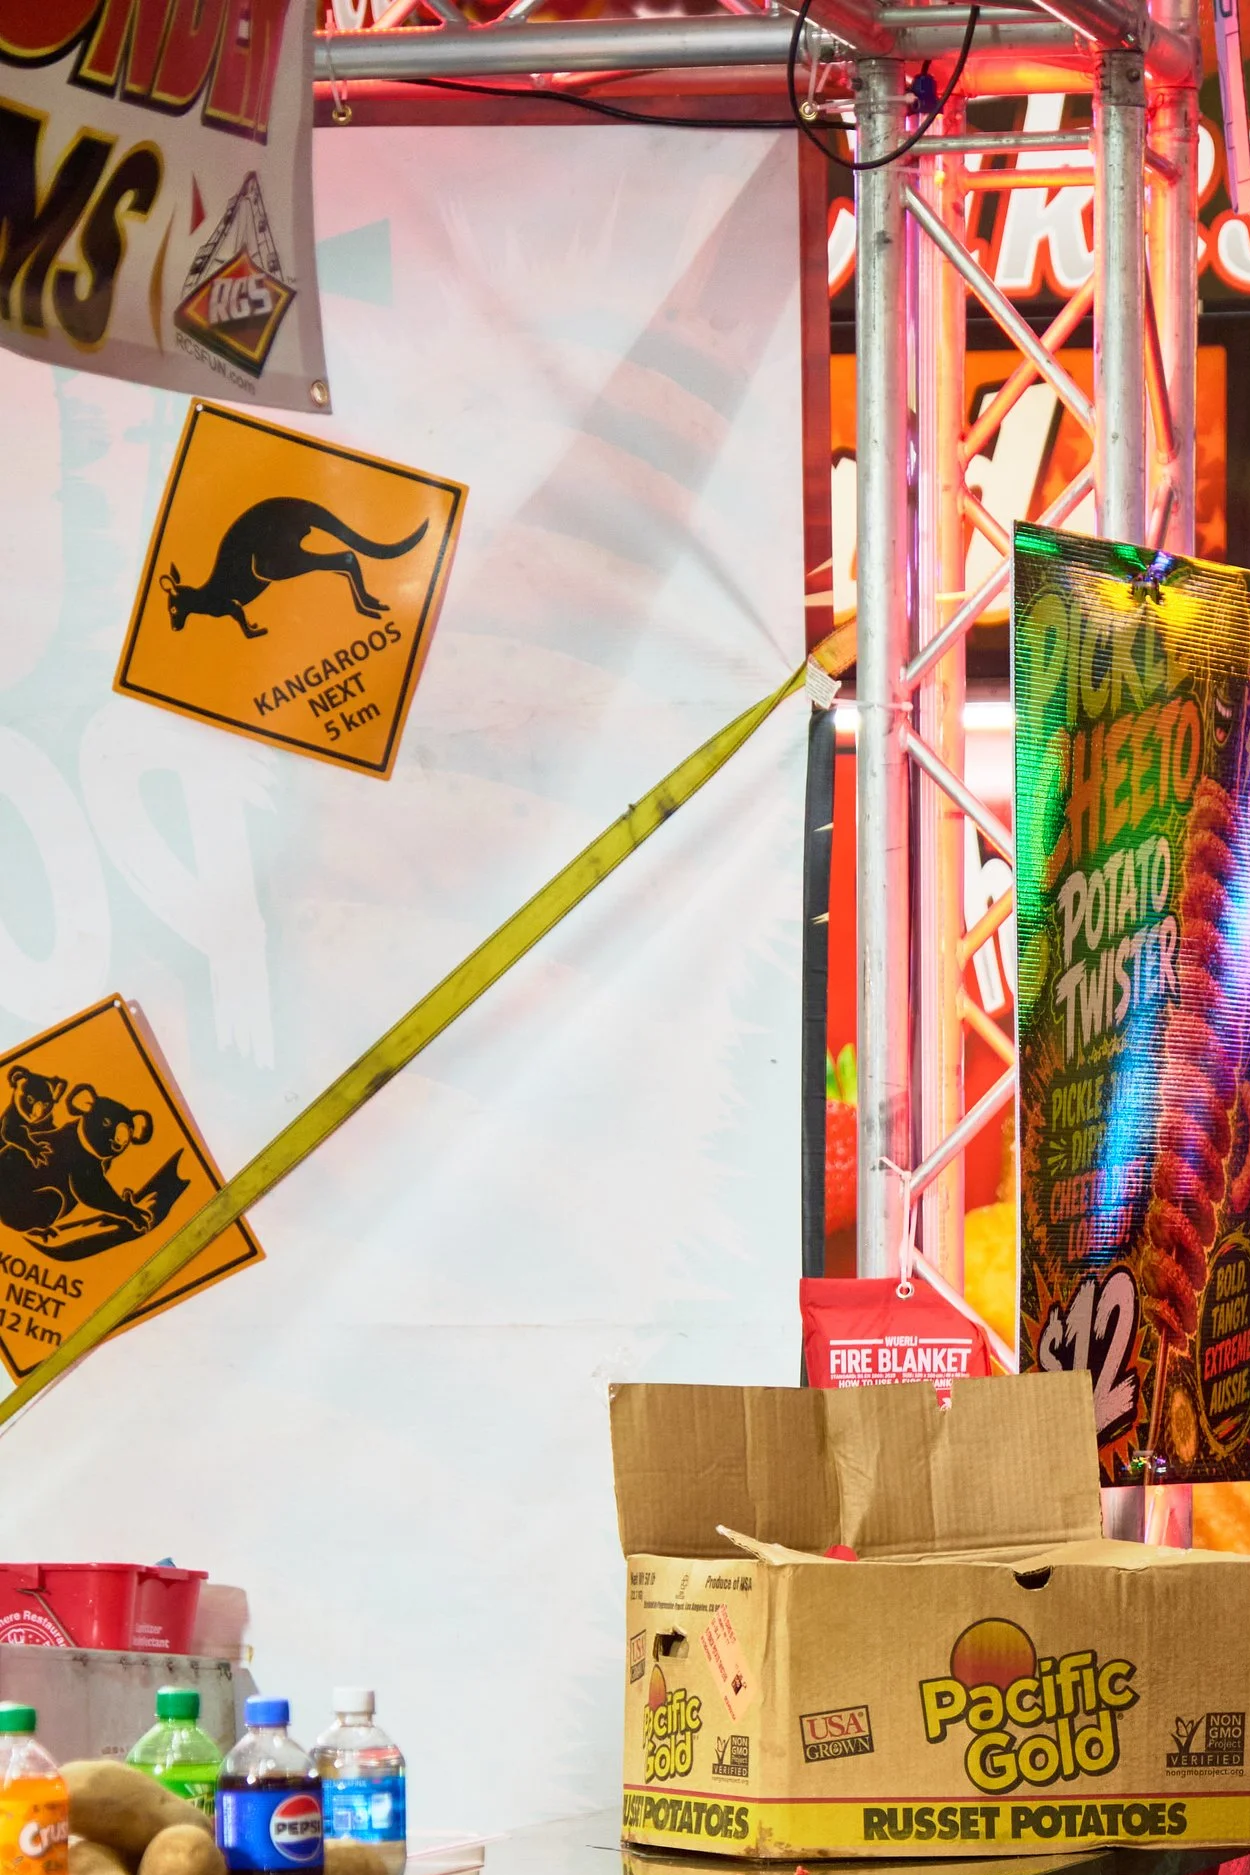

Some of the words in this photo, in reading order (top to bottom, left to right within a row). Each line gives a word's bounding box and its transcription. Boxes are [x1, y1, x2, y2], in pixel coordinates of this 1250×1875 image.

[208, 273, 274, 326] RCS
[175, 332, 257, 396] RCSFUN.com
[253, 620, 402, 716] KANGAROOS
[307, 671, 366, 718] NEXT
[324, 719, 341, 741] 5
[339, 702, 381, 732] km
[1057, 834, 1172, 970] POTATO
[1055, 915, 1182, 1064] TWISTER
[0, 1251, 84, 1299] KOALAS
[1216, 1260, 1247, 1300] BOLD.
[5, 1283, 66, 1319] NEXT
[1211, 1294, 1249, 1339] TANGY.
[25, 1316, 62, 1347] km
[884, 1336, 918, 1347] WUERLI
[829, 1348, 873, 1375] FIRE
[877, 1347, 972, 1374] BLANKET
[705, 1575, 731, 1590] Produce
[733, 1576, 740, 1590] of
[23, 1609, 68, 1648] Restauran
[920, 1650, 1140, 1743] Pacific
[808, 1712, 864, 1741] USA
[1209, 1714, 1242, 1726] NON
[1209, 1727, 1242, 1739] GMO
[732, 1737, 748, 1747] NON
[732, 1746, 748, 1757] GMO
[806, 1737, 872, 1762] GROWN
[964, 1708, 1120, 1795] Gold
[1171, 1754, 1241, 1766] VERIFIED
[1208, 1739, 1242, 1750] Project
[714, 1764, 748, 1777] VERIFIED
[1165, 1767, 1245, 1778] nongmoproject.org
[275, 1819, 321, 1836] PEPSI
[643, 1796, 749, 1840] POTATOES
[862, 1806, 1001, 1841] RUSSET
[1011, 1803, 1188, 1839] POTATOES
[19, 1820, 69, 1858] Crus
